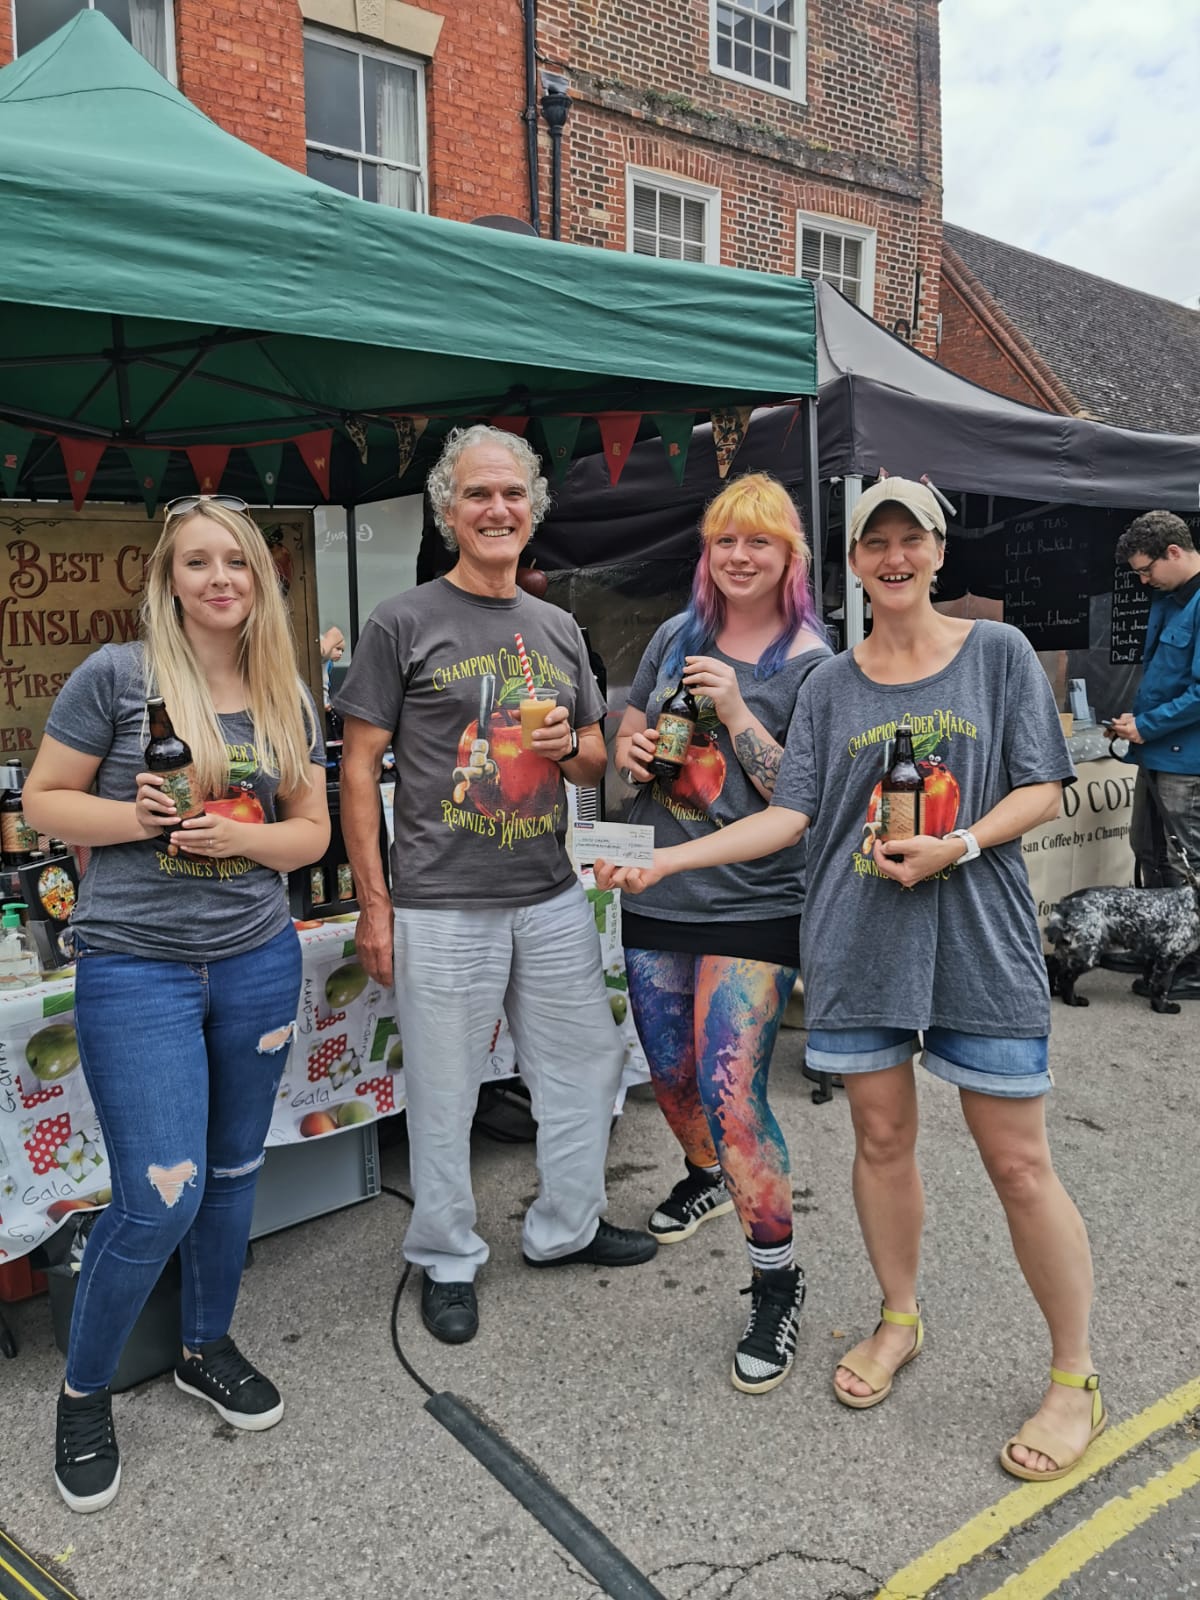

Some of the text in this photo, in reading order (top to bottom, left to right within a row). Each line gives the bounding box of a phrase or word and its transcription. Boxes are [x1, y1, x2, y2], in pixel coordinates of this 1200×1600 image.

[1041, 517, 1069, 529] TEAS
[6, 539, 104, 599] BEST
[0, 664, 72, 711] FIRS
[432, 653, 497, 692] CHAMPION
[498, 647, 535, 685] CIDER
[225, 743, 250, 762] DER
[848, 720, 899, 758] CHAMPION
[934, 709, 977, 742] MAKER
[1087, 776, 1135, 814] COF
[495, 808, 556, 851] WINSLOW
[1041, 832, 1072, 851] Coffee
[1073, 831, 1086, 848] by
[1087, 834, 1093, 843] a
[1095, 822, 1130, 841] Champi
[300, 977, 313, 1035] Granny
[290, 1087, 330, 1109] Gala
[22, 1180, 76, 1206] Gala
